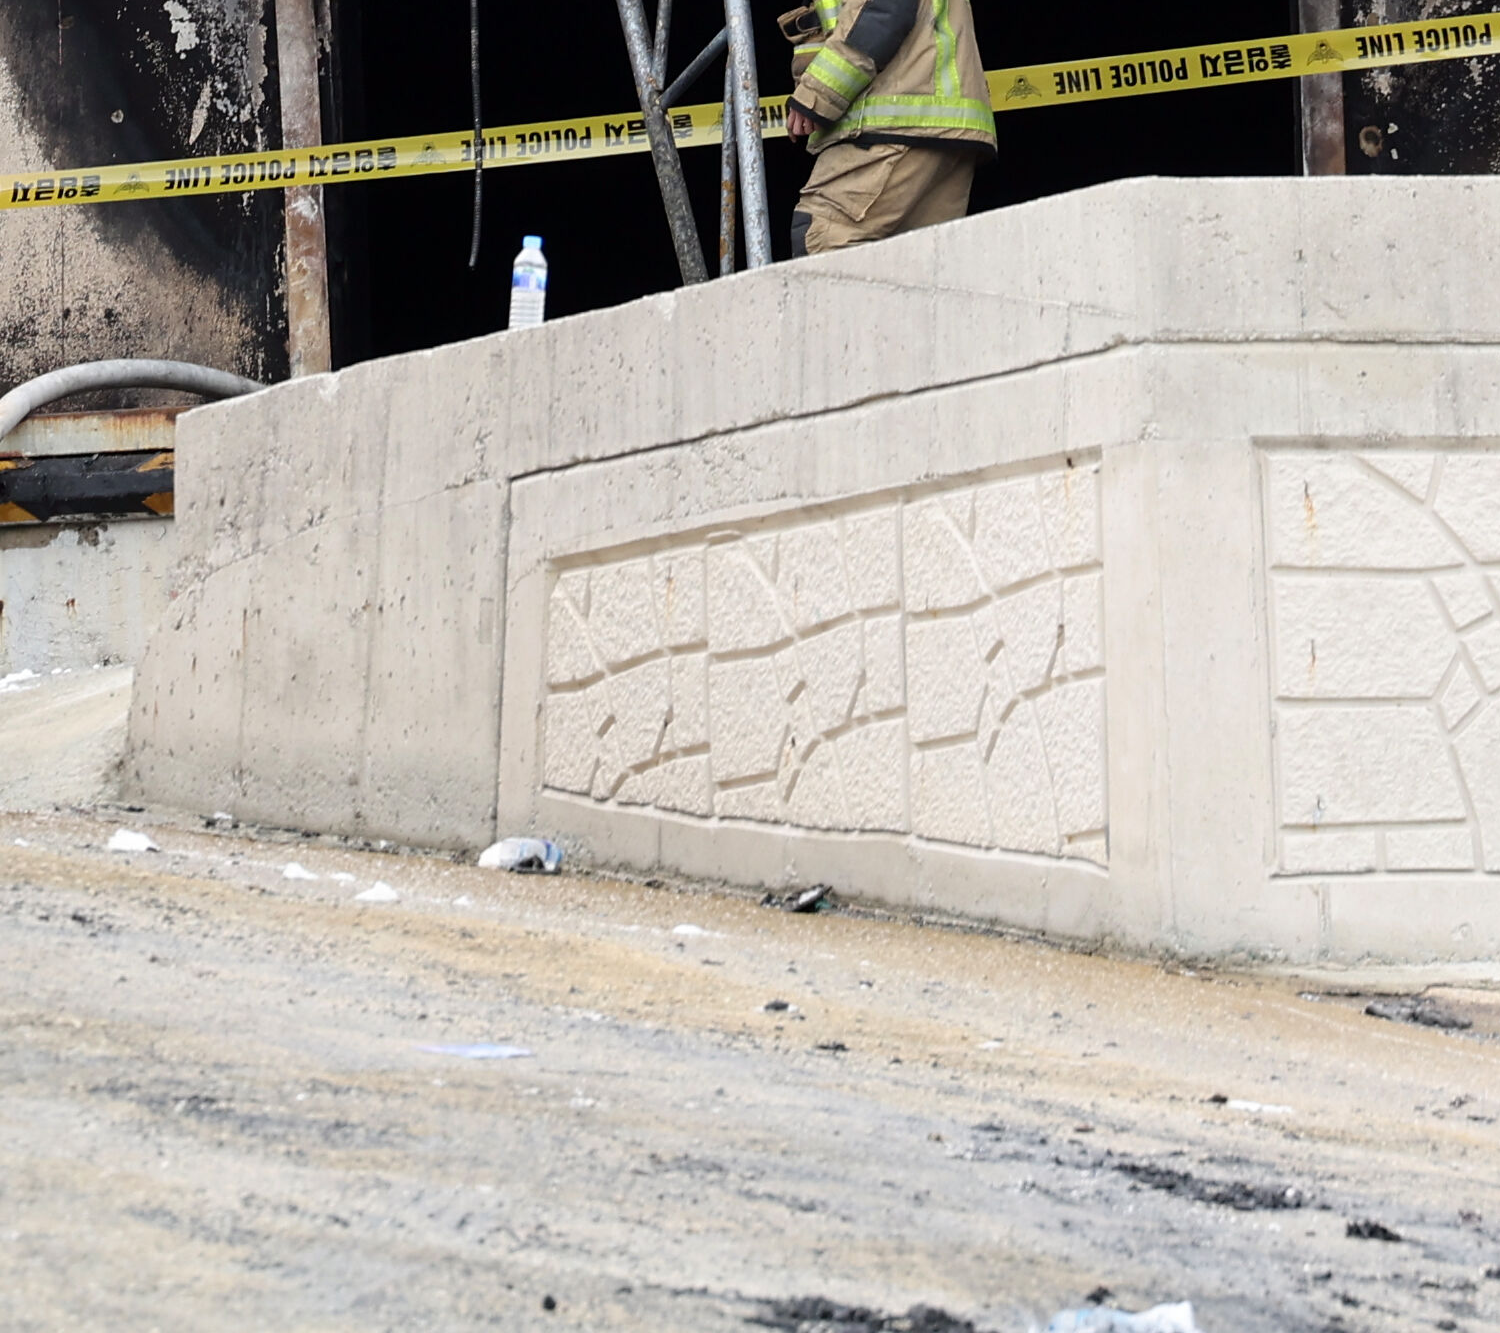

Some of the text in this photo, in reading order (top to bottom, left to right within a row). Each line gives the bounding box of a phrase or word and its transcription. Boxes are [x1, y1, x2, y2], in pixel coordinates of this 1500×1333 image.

[1356, 34, 1404, 59] LINE
[1412, 23, 1492, 53] POLICE
[1053, 44, 1292, 95] 출입금지 POLICE LINE
[516, 126, 592, 155] POLICE
[604, 114, 693, 147] 출금지
[164, 146, 397, 190] 출입금지 POLICE LINE
[11, 175, 100, 203] 출입금지
